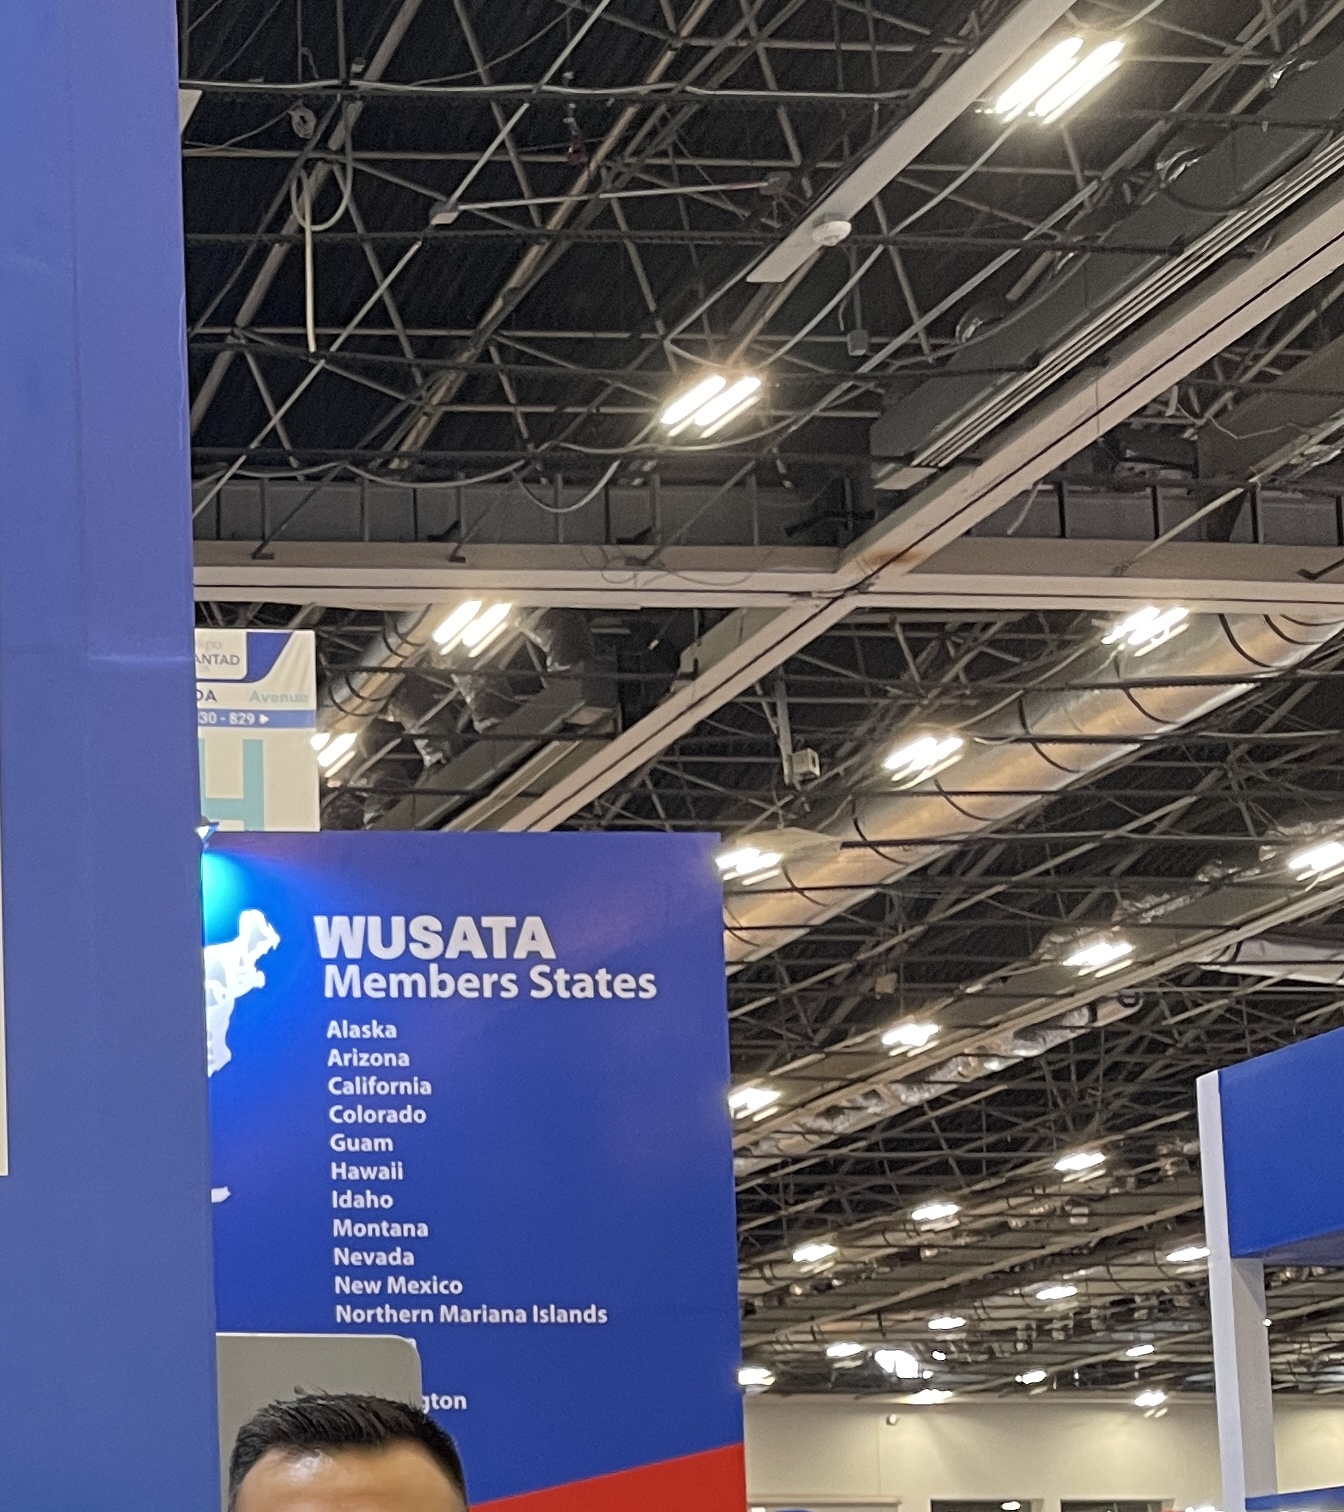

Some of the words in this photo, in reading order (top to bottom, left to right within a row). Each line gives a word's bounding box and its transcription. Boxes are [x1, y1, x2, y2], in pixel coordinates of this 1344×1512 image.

[249, 689, 309, 704] Avenue
[229, 712, 255, 725] 829
[314, 914, 557, 960] WUSATA
[325, 962, 519, 999] Members
[529, 964, 657, 1000] States
[326, 1019, 397, 1039] Alaska
[327, 1047, 410, 1067] Arizona
[328, 1075, 432, 1096] California
[329, 1104, 427, 1124] Colorado
[330, 1133, 394, 1152] Guam
[331, 1161, 404, 1181] Hawaii
[332, 1189, 394, 1209] Idaho
[333, 1218, 429, 1238] Montana
[333, 1246, 415, 1266] Nevada
[334, 1276, 383, 1295] New
[387, 1275, 463, 1295] Mexico
[335, 1304, 434, 1323] Northern
[439, 1304, 527, 1323] Mariana
[531, 1304, 608, 1323] Islands
